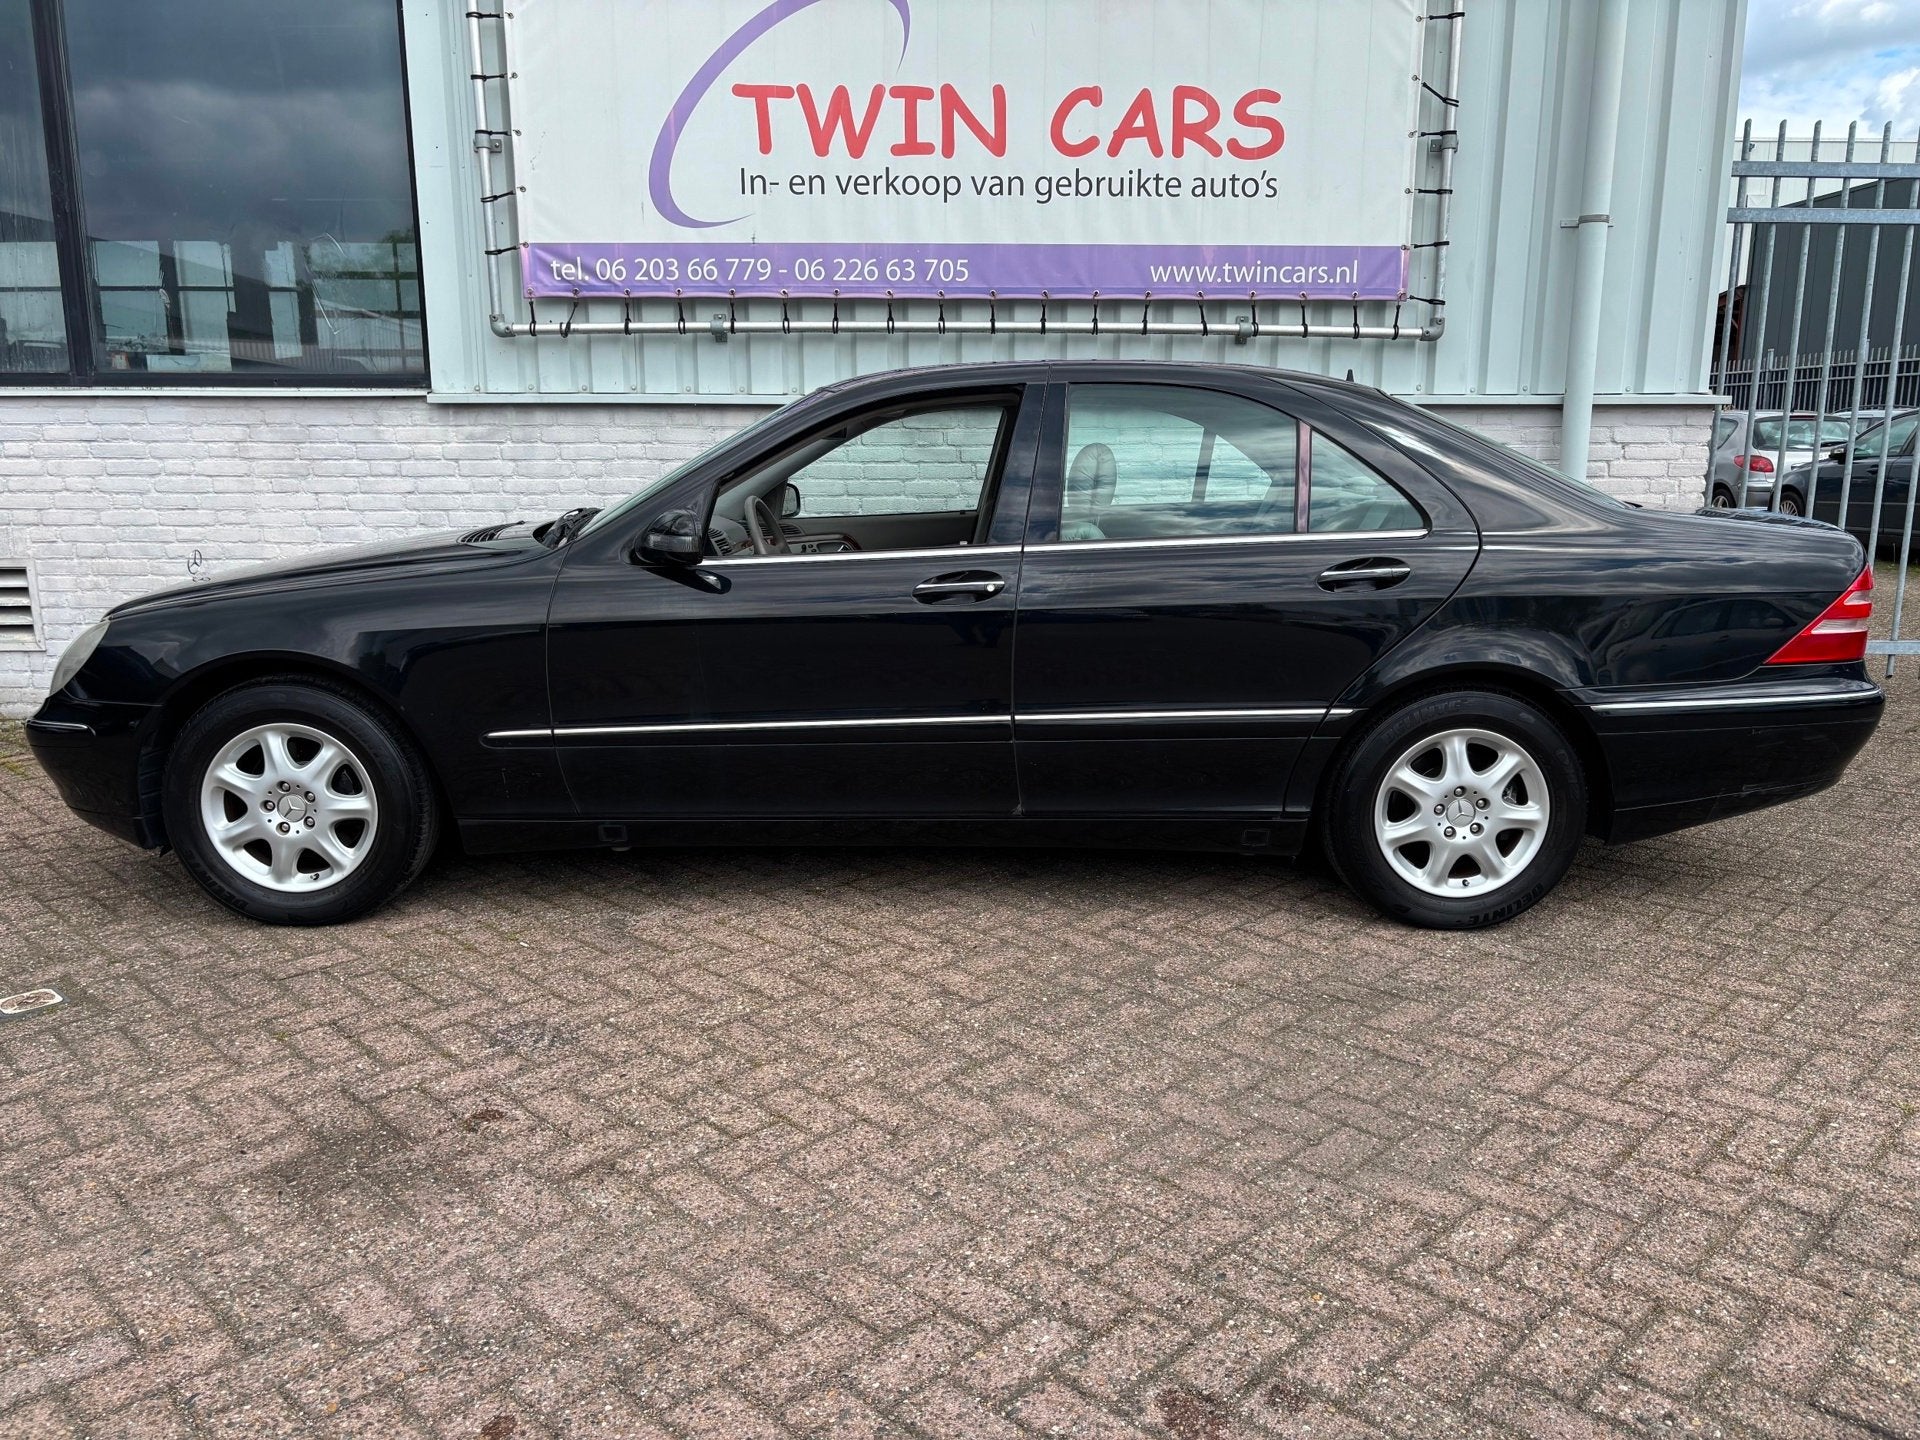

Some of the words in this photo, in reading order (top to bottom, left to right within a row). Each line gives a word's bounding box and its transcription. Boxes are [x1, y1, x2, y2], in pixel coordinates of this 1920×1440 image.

[732, 83, 1007, 159] TWIN
[1050, 85, 1285, 160] CARS
[740, 167, 780, 195] In-
[789, 174, 825, 196] en
[835, 167, 962, 204] verkoop
[970, 176, 1024, 197] van
[1034, 168, 1182, 205] gebruikte
[1191, 169, 1278, 198] auto’s
[550, 256, 589, 281] tel.
[595, 258, 627, 281] 06
[634, 257, 679, 281] 203
[687, 257, 718, 281] 66
[725, 258, 772, 281] 779
[794, 258, 826, 281] 06
[832, 257, 881, 282] 226
[885, 258, 916, 282] 63
[924, 259, 969, 282] 705
[1150, 260, 1358, 284] www.twincars.nl
